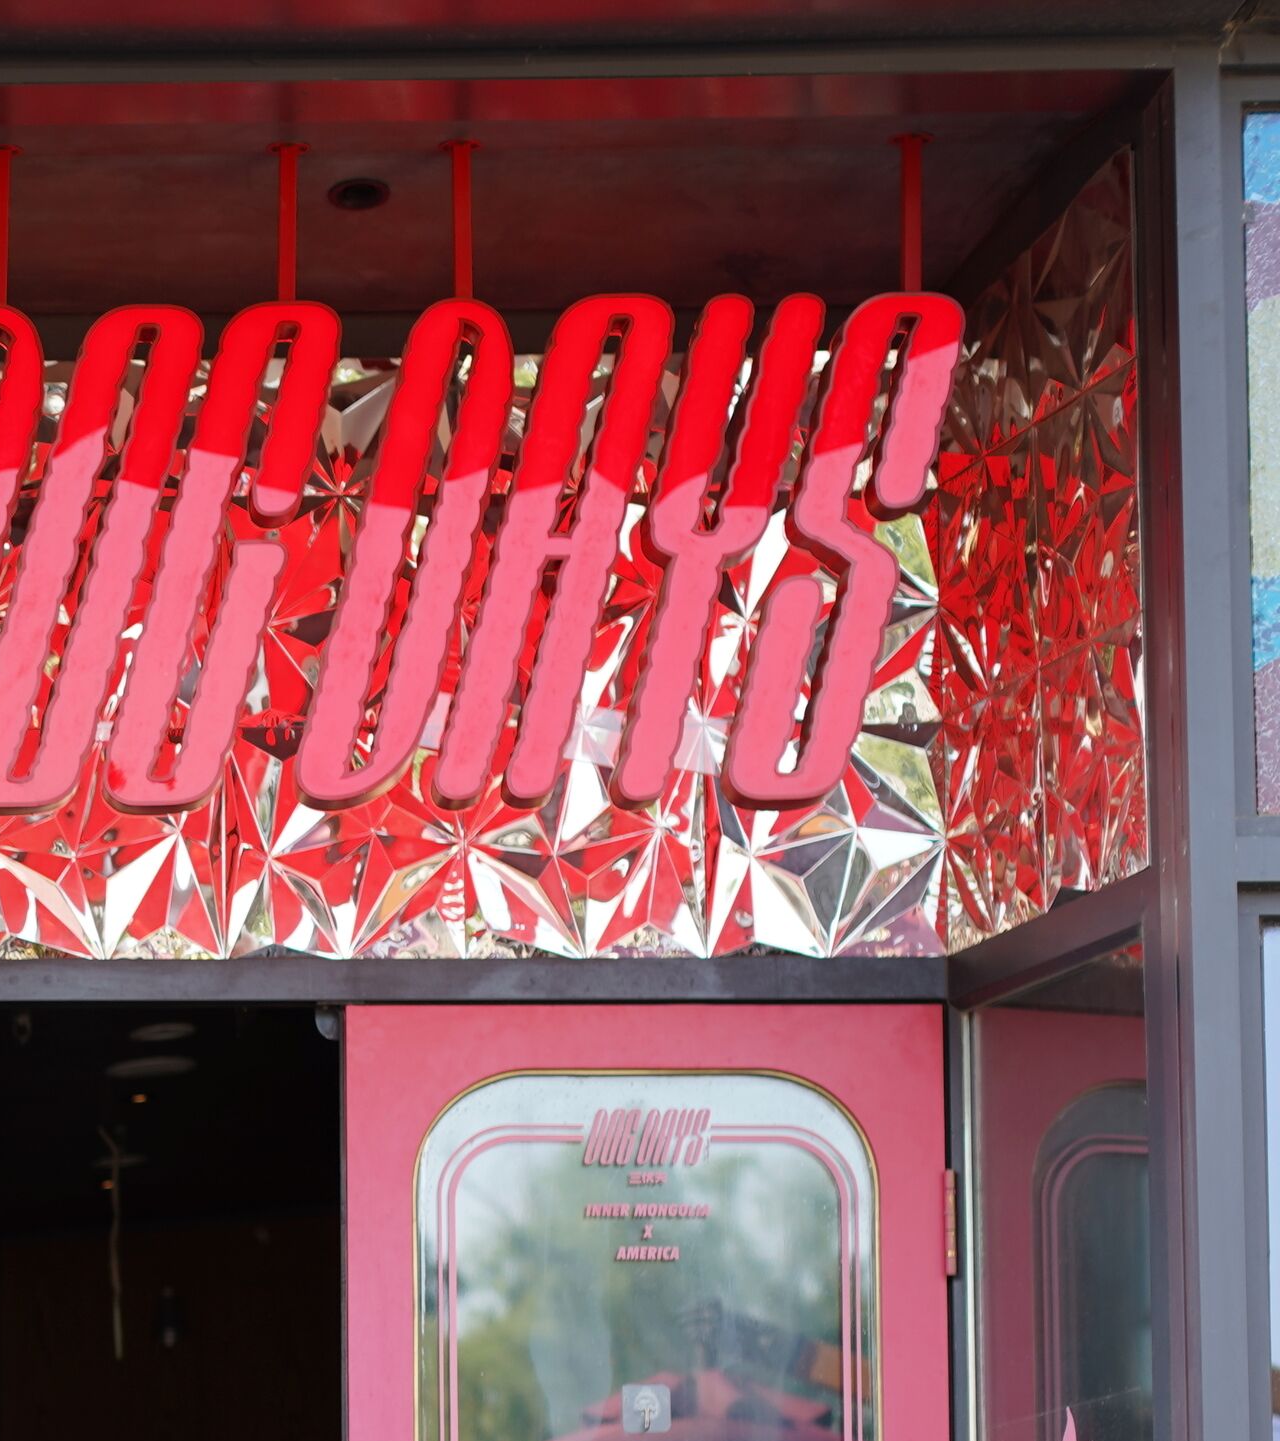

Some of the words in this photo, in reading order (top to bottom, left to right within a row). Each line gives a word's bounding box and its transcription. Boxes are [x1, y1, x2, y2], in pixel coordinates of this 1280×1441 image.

[297, 292, 966, 814] DAYS
[583, 1107, 641, 1166] DOG
[635, 1107, 711, 1167] DAYS
[585, 1203, 630, 1218] INNER
[632, 1203, 711, 1218] MONGOLIA
[615, 1246, 680, 1261] AMERICA
